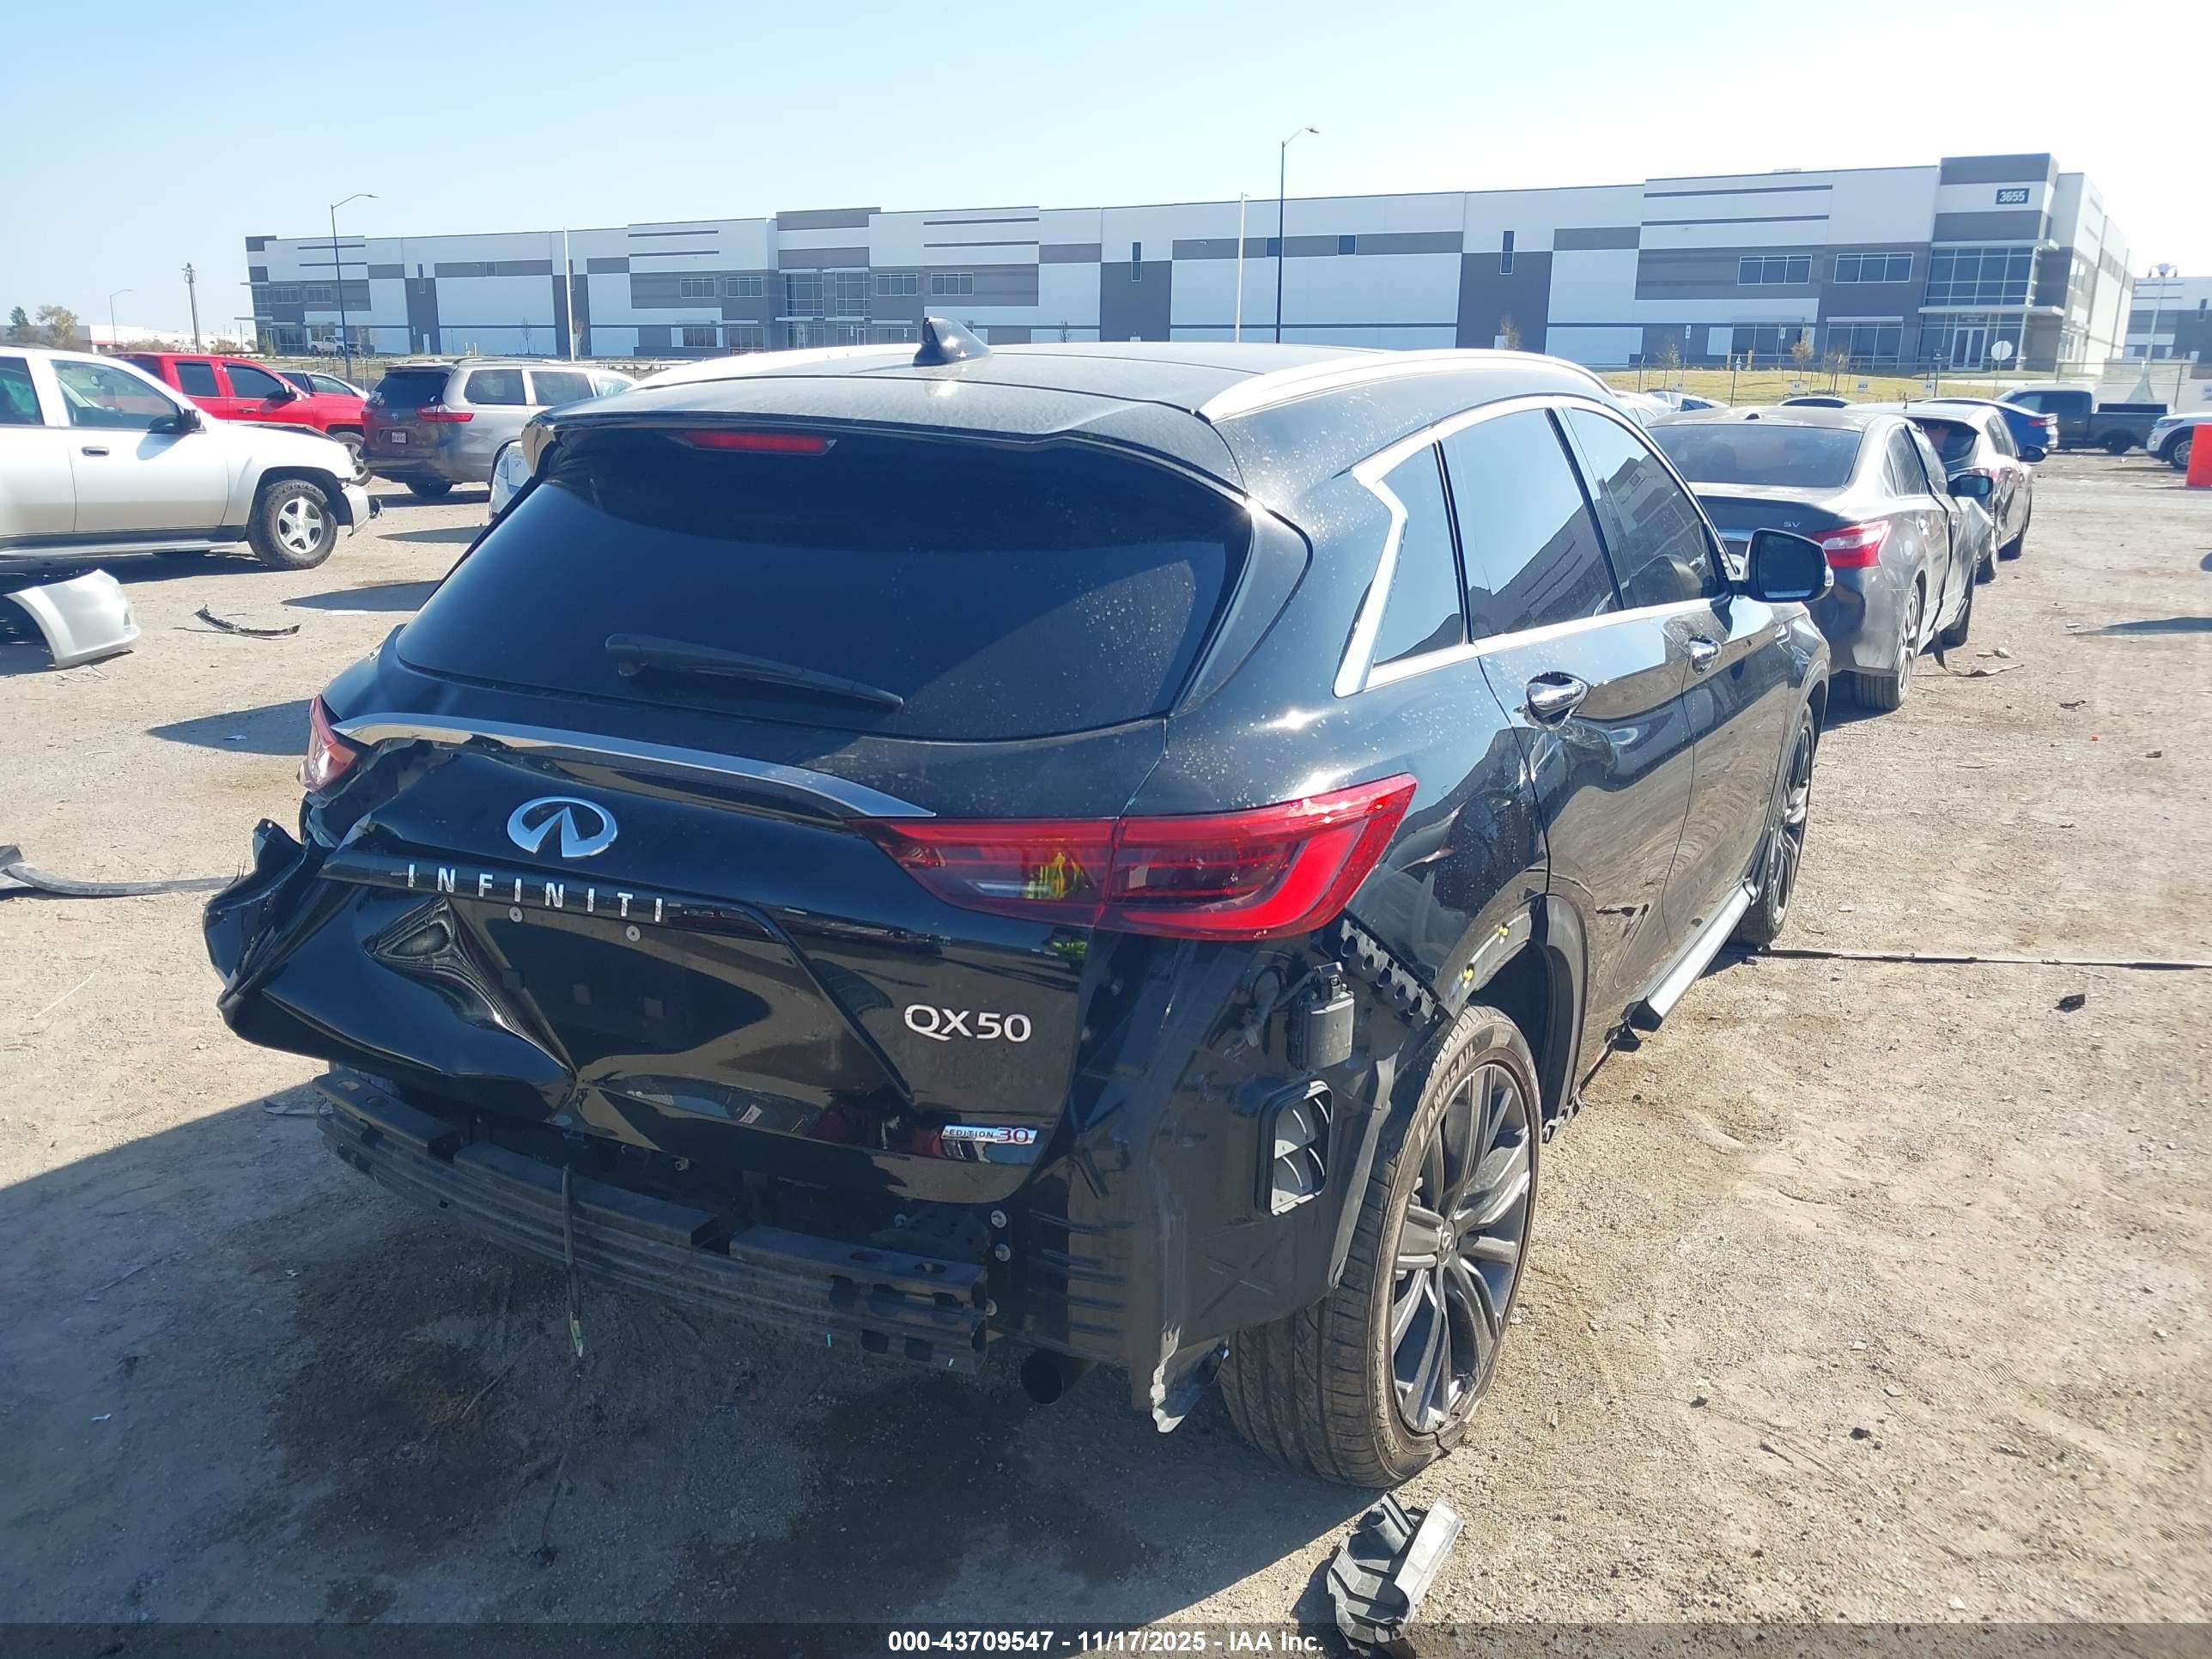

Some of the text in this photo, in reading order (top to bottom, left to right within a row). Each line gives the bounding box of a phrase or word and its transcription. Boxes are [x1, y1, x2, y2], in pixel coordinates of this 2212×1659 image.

[1999, 191, 2026, 203] 3655
[406, 863, 664, 923] INFINITI
[903, 1004, 1031, 1042] QX50
[949, 1127, 1030, 1143] EDITION 30
